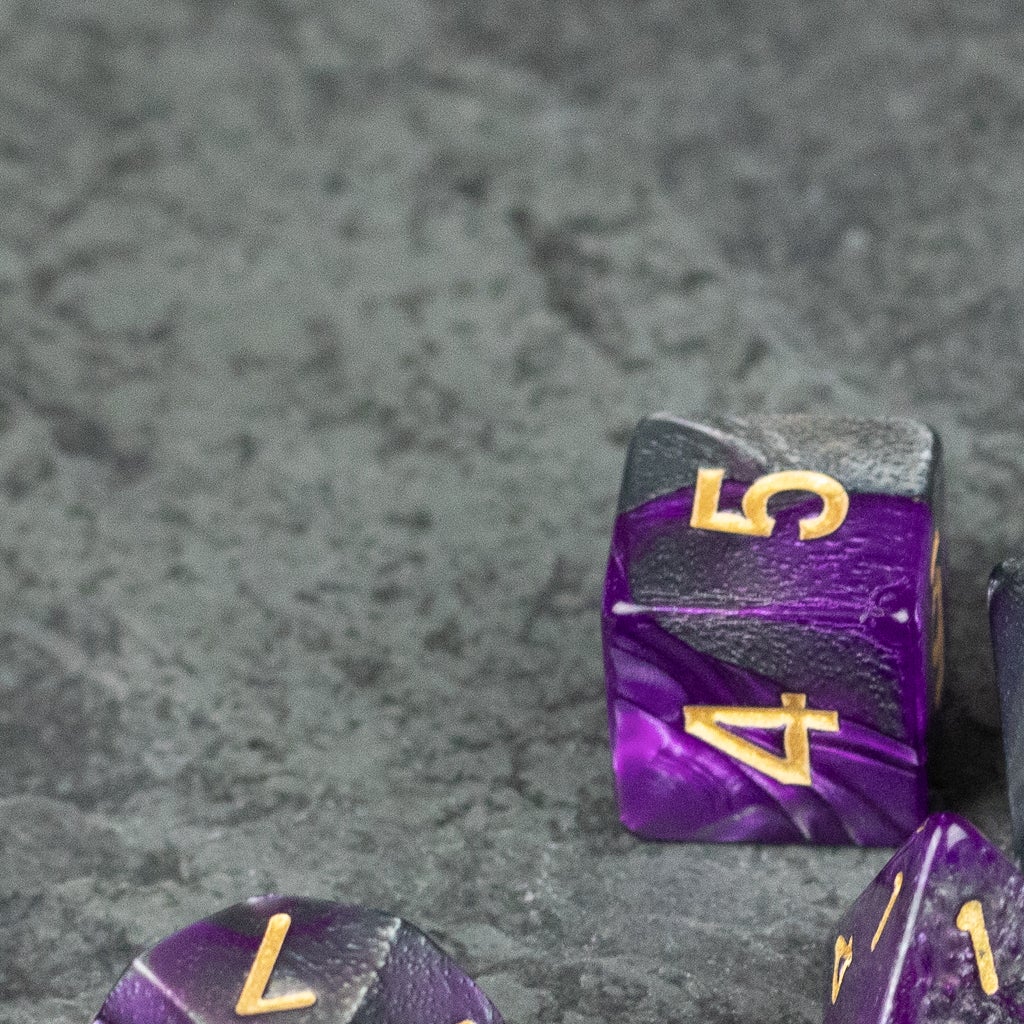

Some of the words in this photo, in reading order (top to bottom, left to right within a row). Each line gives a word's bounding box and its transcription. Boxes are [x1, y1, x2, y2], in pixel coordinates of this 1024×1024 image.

[690, 467, 849, 540] 5
[683, 691, 840, 786] 4
[871, 871, 903, 952] 1
[955, 899, 999, 996] 1
[235, 912, 317, 1017] 7
[831, 934, 853, 1004] 4
